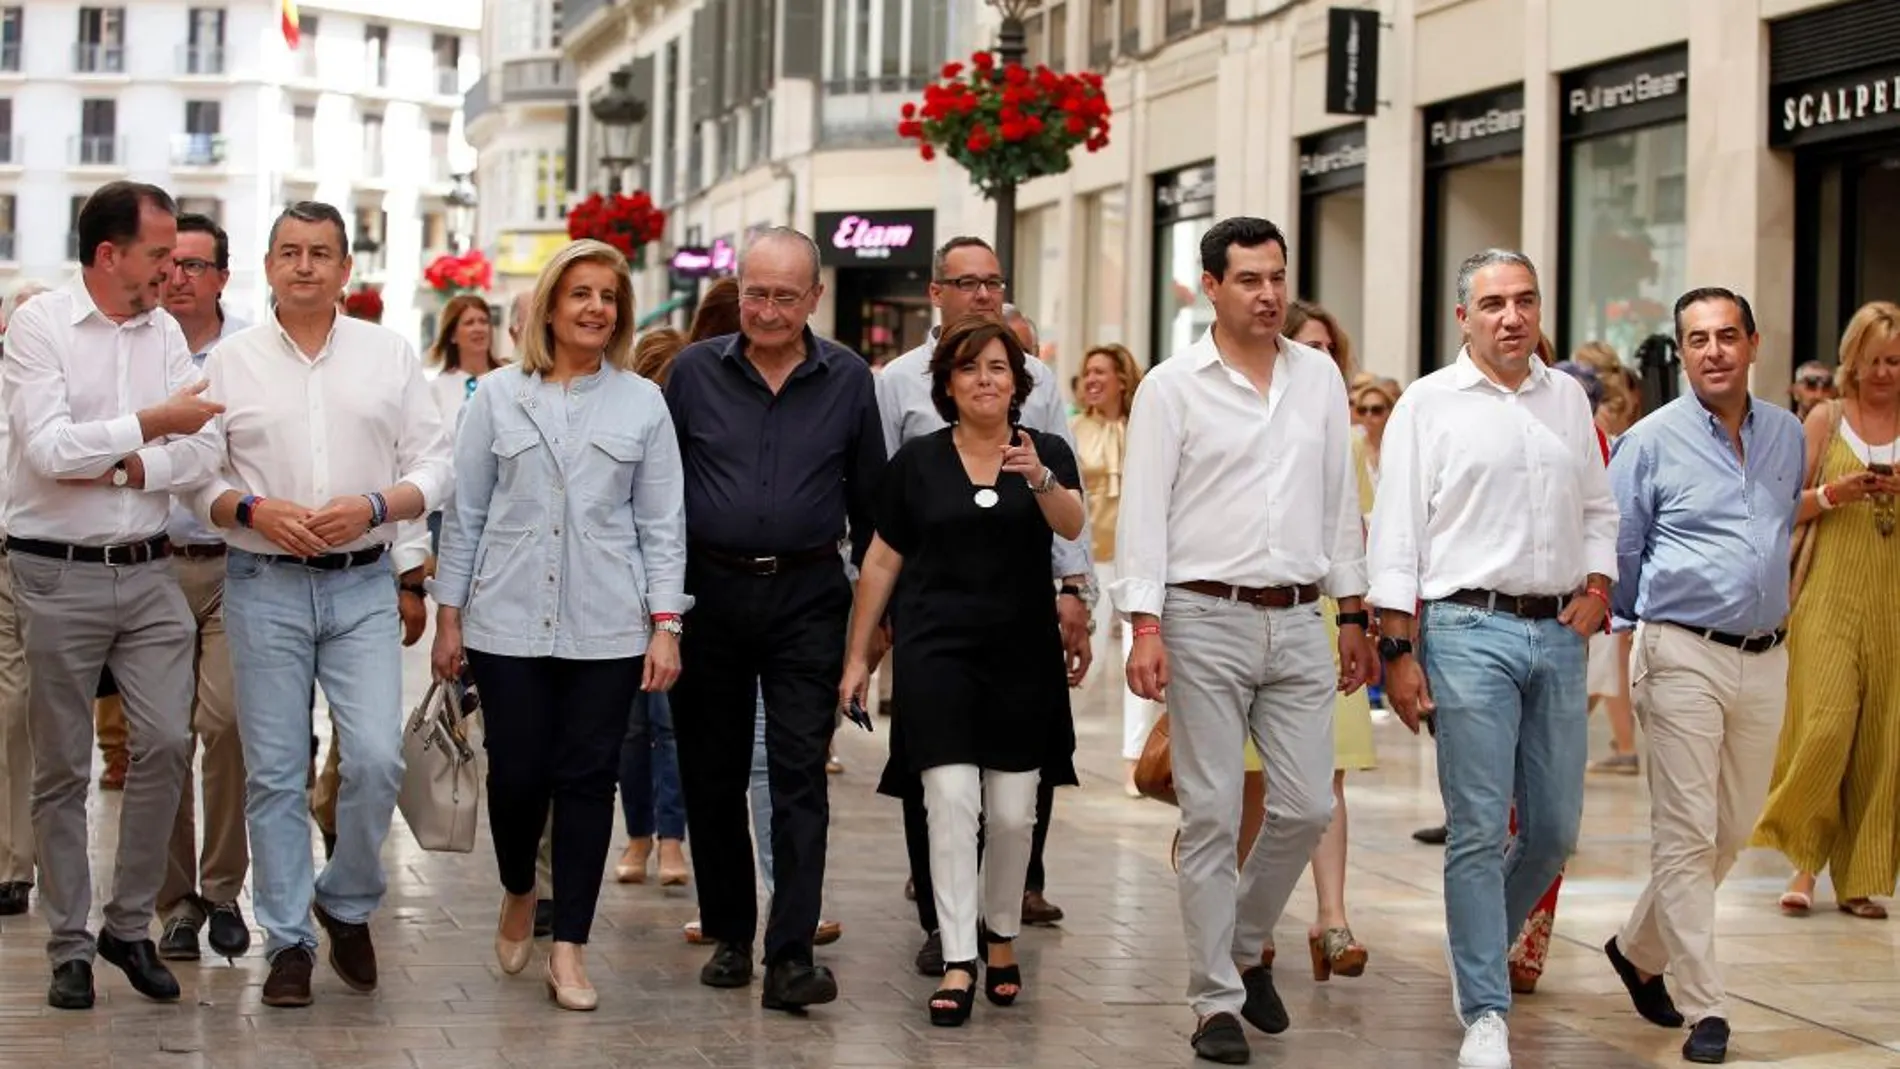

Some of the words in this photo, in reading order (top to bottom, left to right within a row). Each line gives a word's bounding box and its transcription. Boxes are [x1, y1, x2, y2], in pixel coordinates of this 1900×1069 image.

[1602, 81, 1636, 108] and
[1636, 72, 1686, 101] Bear
[833, 215, 913, 249] Etam
